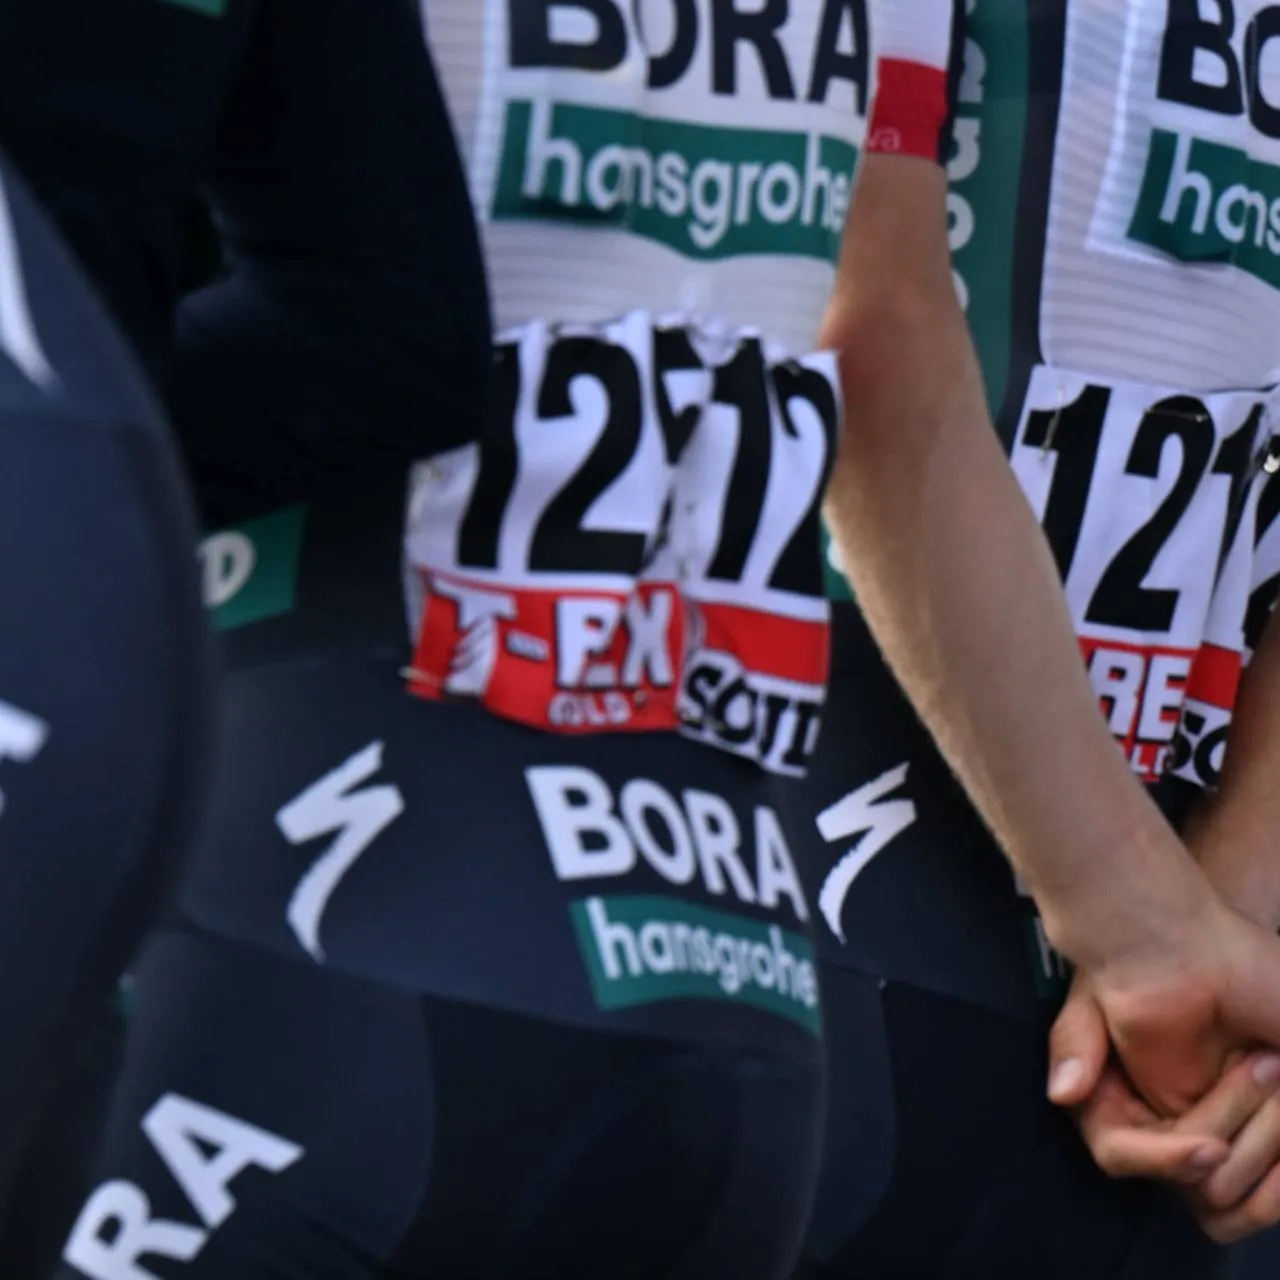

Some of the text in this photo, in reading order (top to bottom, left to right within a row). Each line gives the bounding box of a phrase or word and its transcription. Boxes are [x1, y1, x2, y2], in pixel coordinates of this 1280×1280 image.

[526, 765, 812, 922] BORA
[594, 897, 818, 1008] hansgrohe
[63, 1091, 305, 1280] RA
